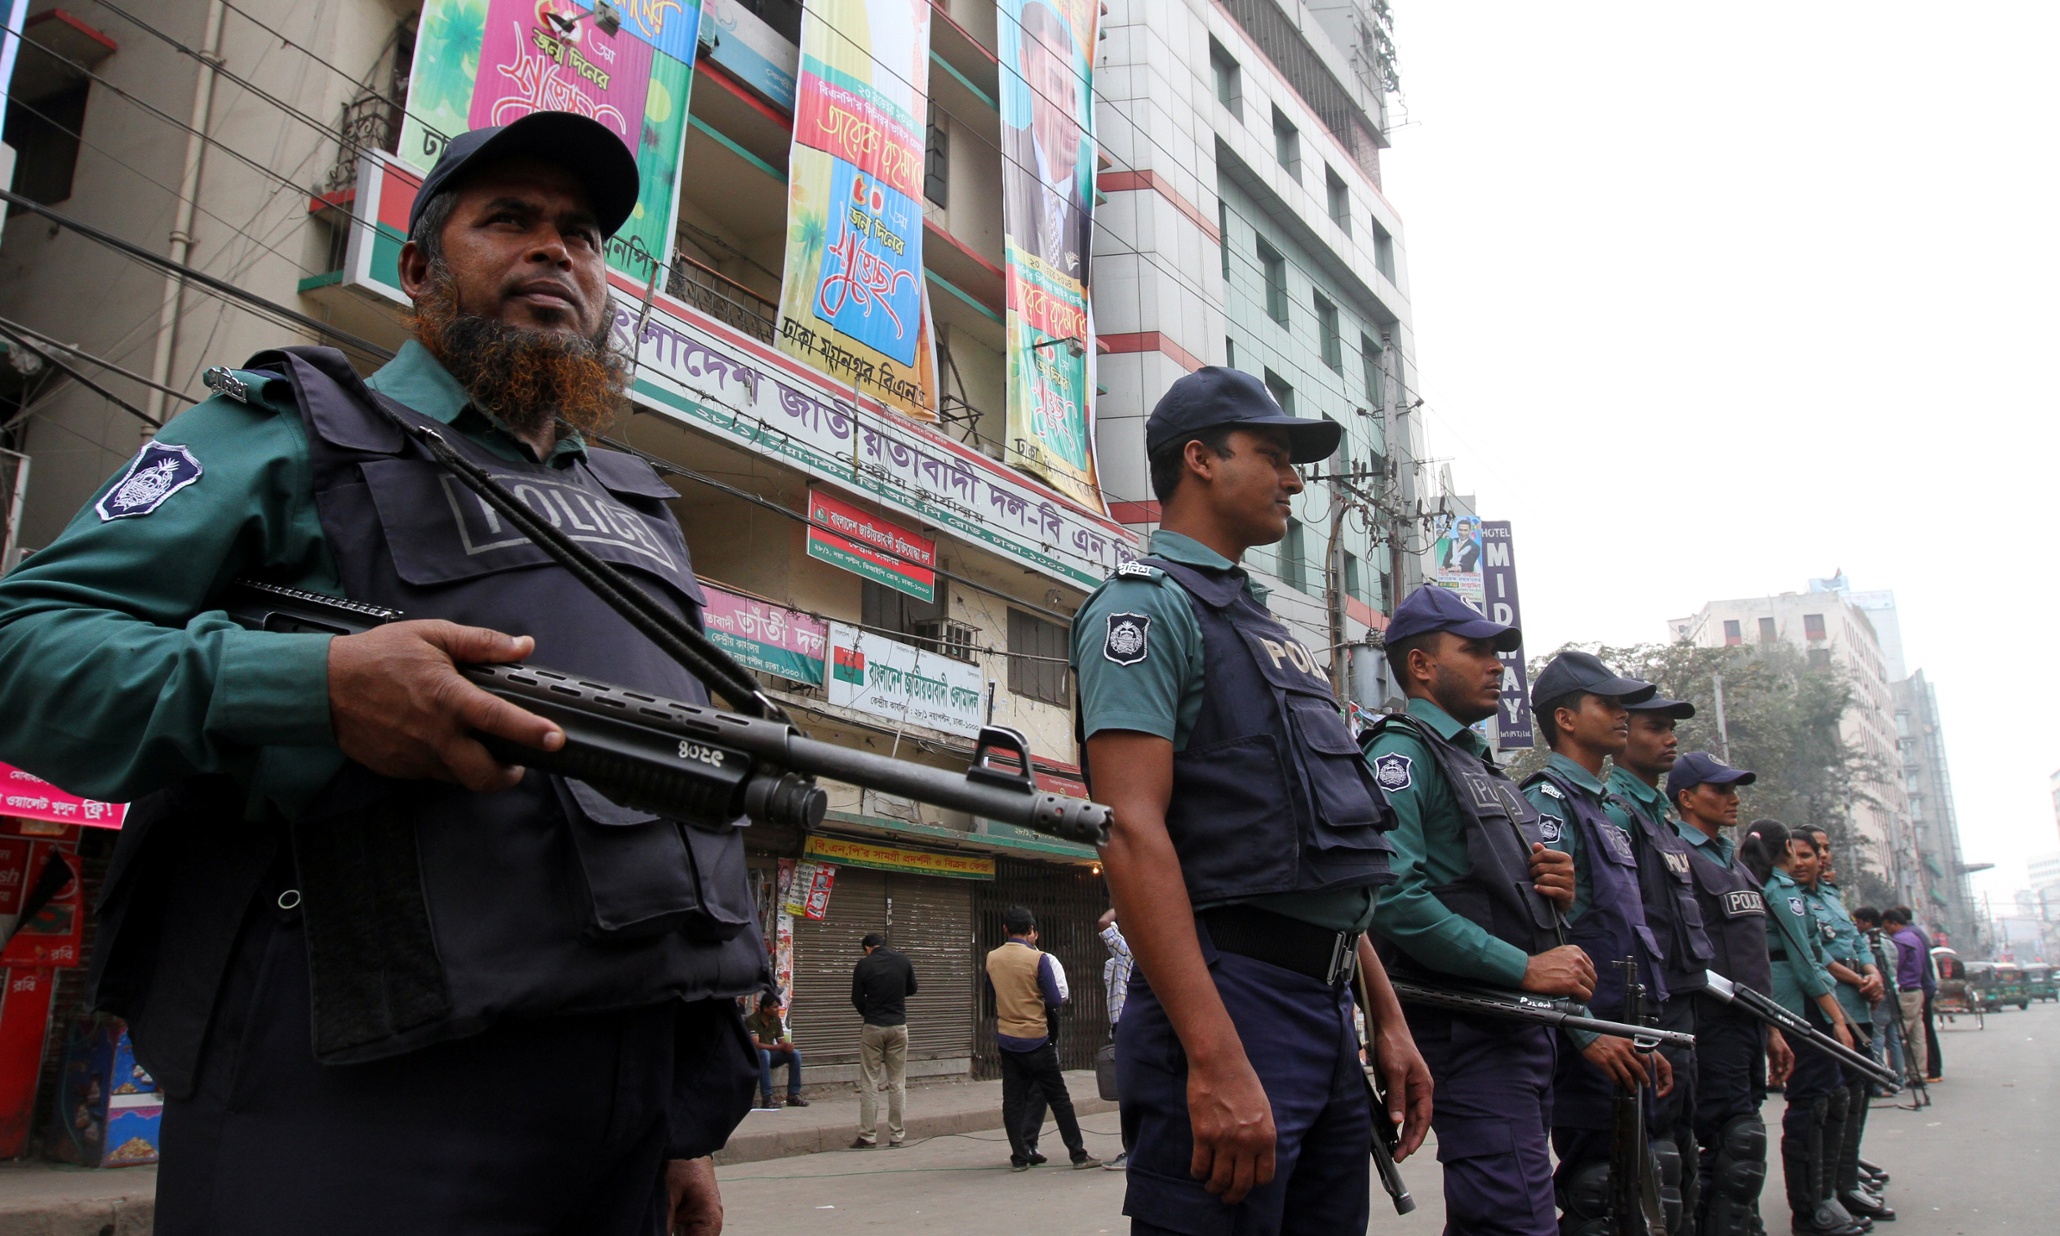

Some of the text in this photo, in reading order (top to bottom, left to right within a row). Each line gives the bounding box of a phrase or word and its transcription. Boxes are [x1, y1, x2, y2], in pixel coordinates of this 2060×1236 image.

[566, 48, 611, 91] দিনের
[873, 215, 905, 257] দিনের
[782, 315, 817, 356] ঢাকা
[1481, 528, 1511, 538] HOTEL
[1117, 561, 1153, 576] পুলিশ
[1486, 542, 1522, 724] MIDAY
[794, 627, 828, 660] দল
[6, 796, 49, 810] ওয়ালেট
[52, 801, 78, 816] খুলুন
[935, 859, 942, 867] ও
[51, 944, 73, 960] রবি
[13, 976, 36, 992] রবি
